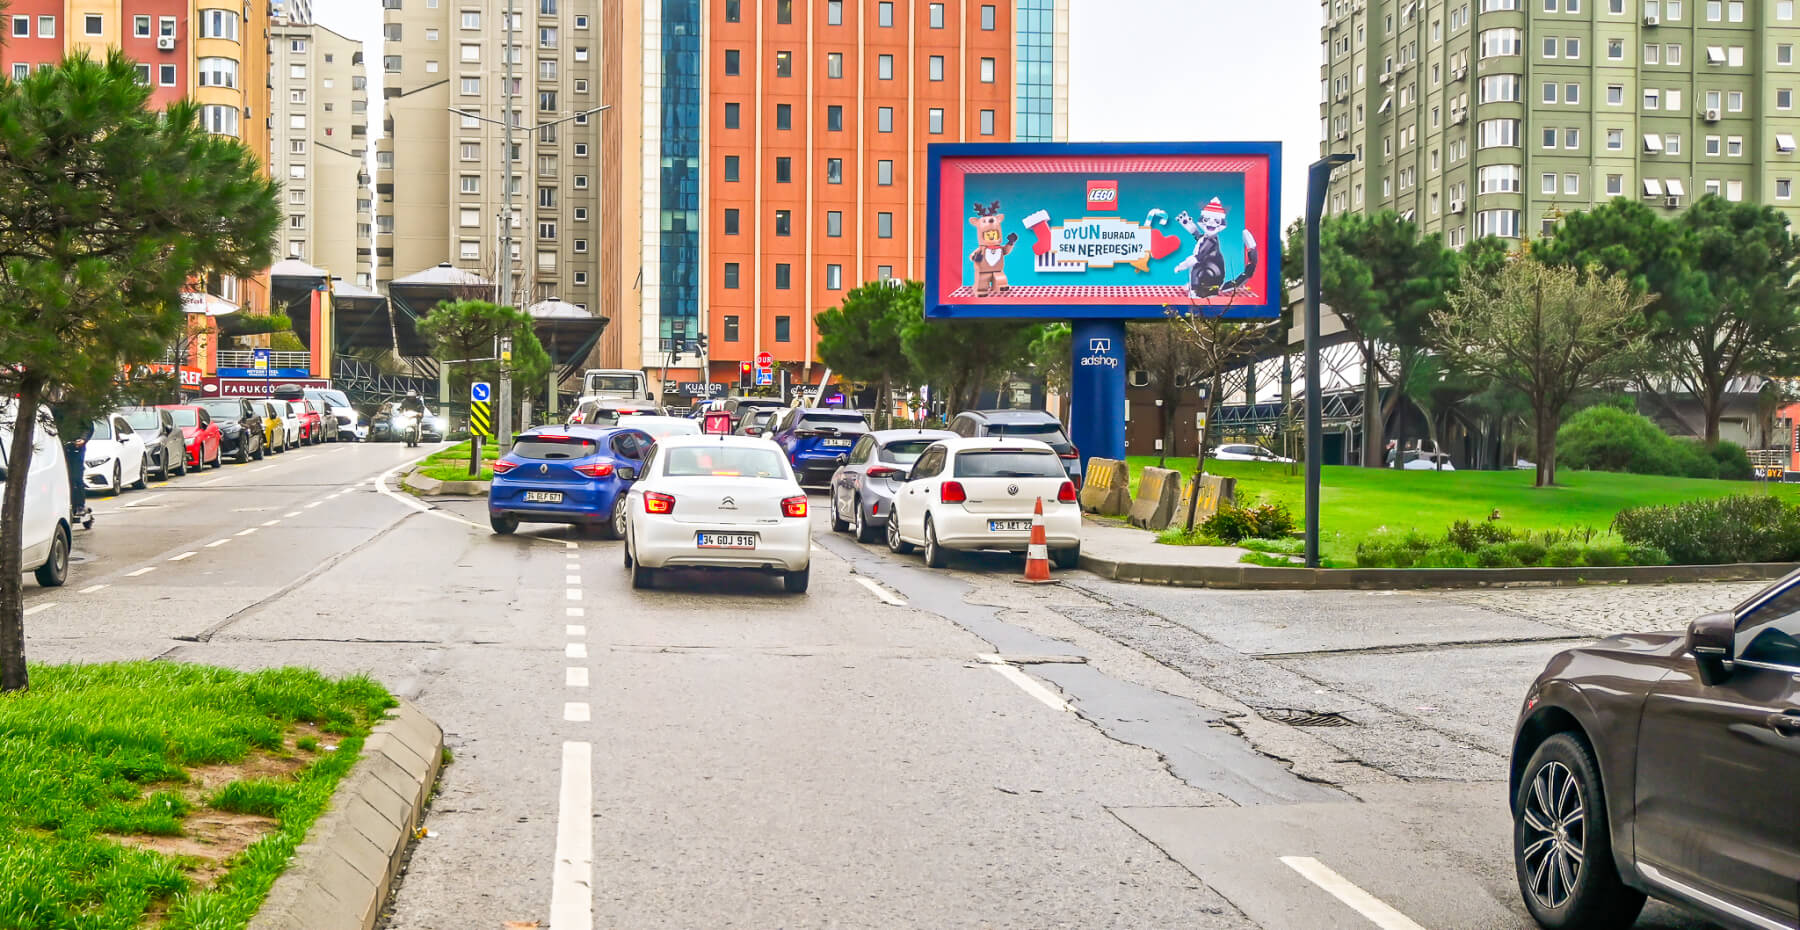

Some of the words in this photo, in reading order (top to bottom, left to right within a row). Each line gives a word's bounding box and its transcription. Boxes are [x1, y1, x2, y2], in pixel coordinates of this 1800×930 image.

[1089, 189, 1116, 202] LEGO
[1064, 224, 1100, 240] OYUN
[1102, 231, 1136, 240] BURADA
[1059, 243, 1075, 253] SEN
[1080, 354, 1118, 369] adshop
[703, 535, 713, 545] 34
[737, 536, 753, 546] 916
